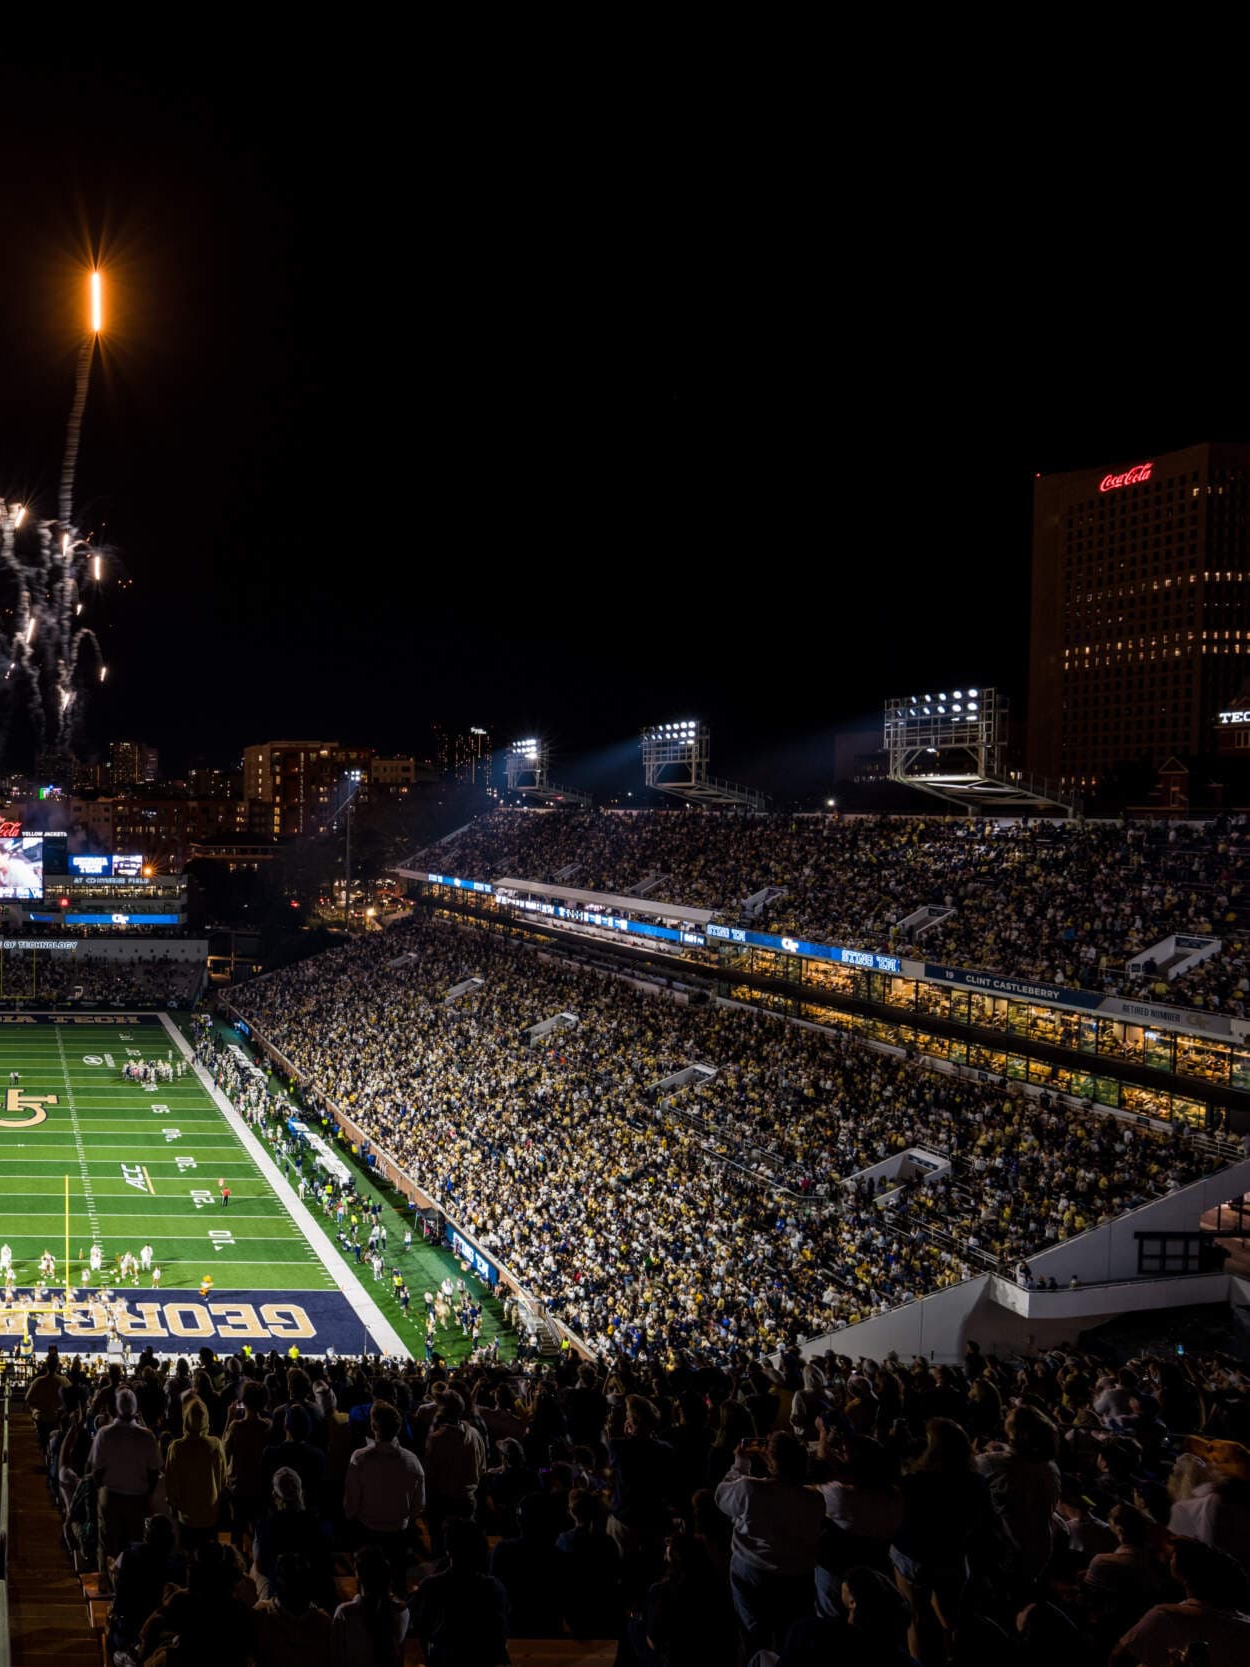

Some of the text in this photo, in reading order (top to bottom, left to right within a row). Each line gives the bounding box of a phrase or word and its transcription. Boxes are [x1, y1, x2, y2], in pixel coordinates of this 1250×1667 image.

[3, 940, 16, 949] OF
[18, 940, 78, 949] TECHNOLOGY
[965, 975, 991, 987] CLINT
[993, 981, 1060, 999] CASTLEBERRY
[48, 1014, 141, 1024] TECH
[1122, 1003, 1149, 1017] RETIRED
[1150, 1009, 1181, 1023] NUMBER
[120, 1163, 149, 1192] ACC
[190, 1190, 215, 1204] 20
[208, 1230, 236, 1245] 10
